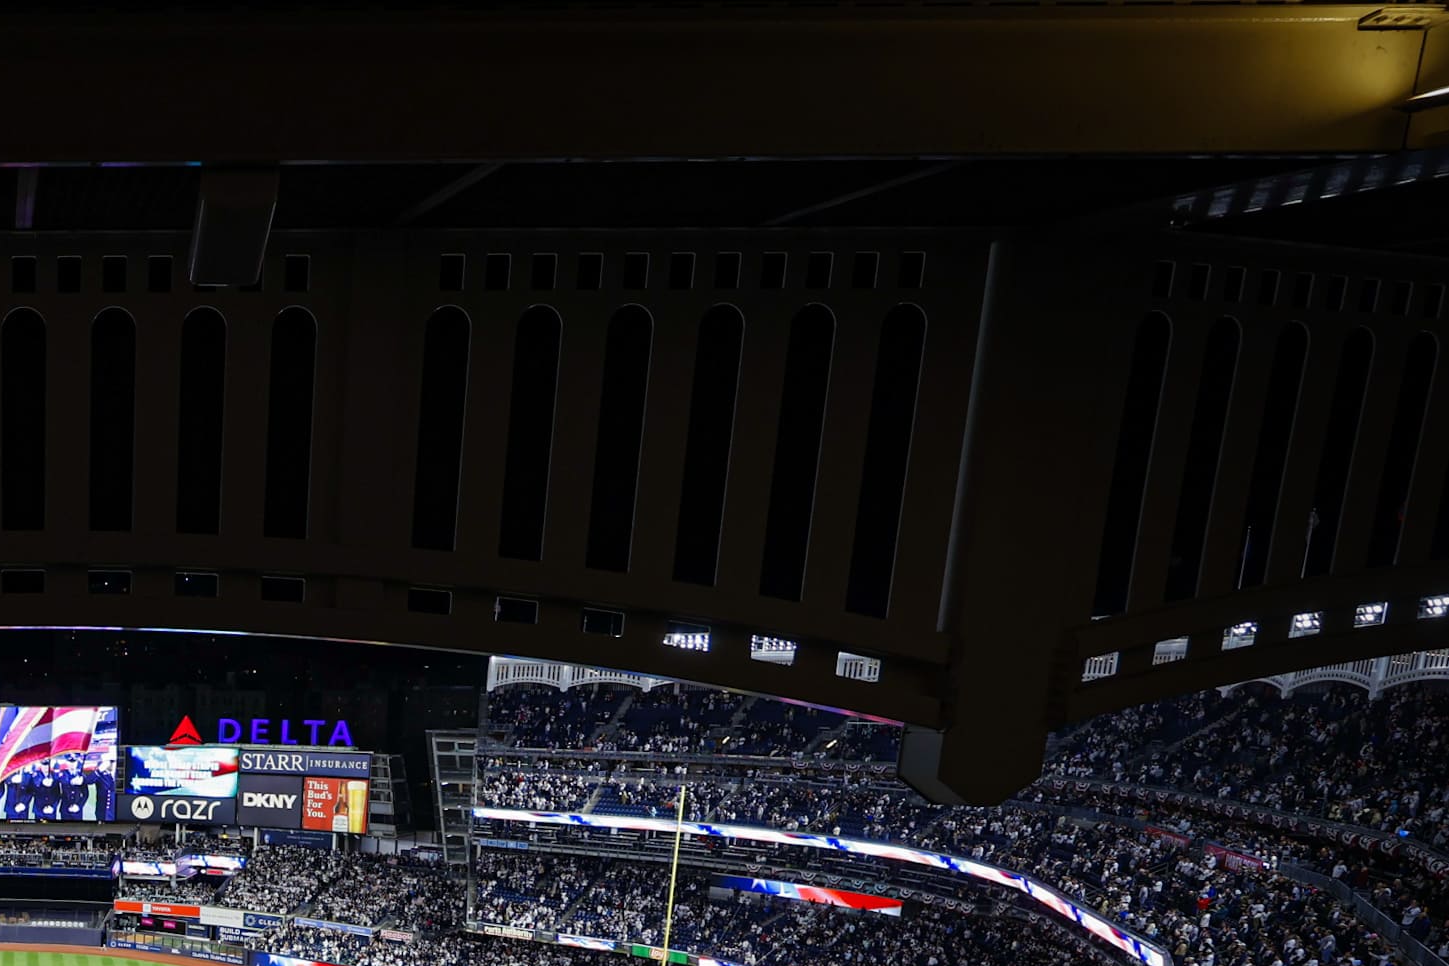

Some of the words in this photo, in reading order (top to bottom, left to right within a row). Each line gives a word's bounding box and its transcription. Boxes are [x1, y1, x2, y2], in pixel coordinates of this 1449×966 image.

[218, 718, 354, 746] DELTA
[241, 753, 304, 771] STARR
[310, 759, 368, 770] INSURANCE
[307, 780, 328, 790] This
[307, 790, 333, 800] Bud's
[243, 792, 297, 809] DKNY
[307, 799, 323, 809] For
[161, 800, 221, 820] razr
[307, 808, 327, 818] You.
[220, 927, 240, 935] BUILD
